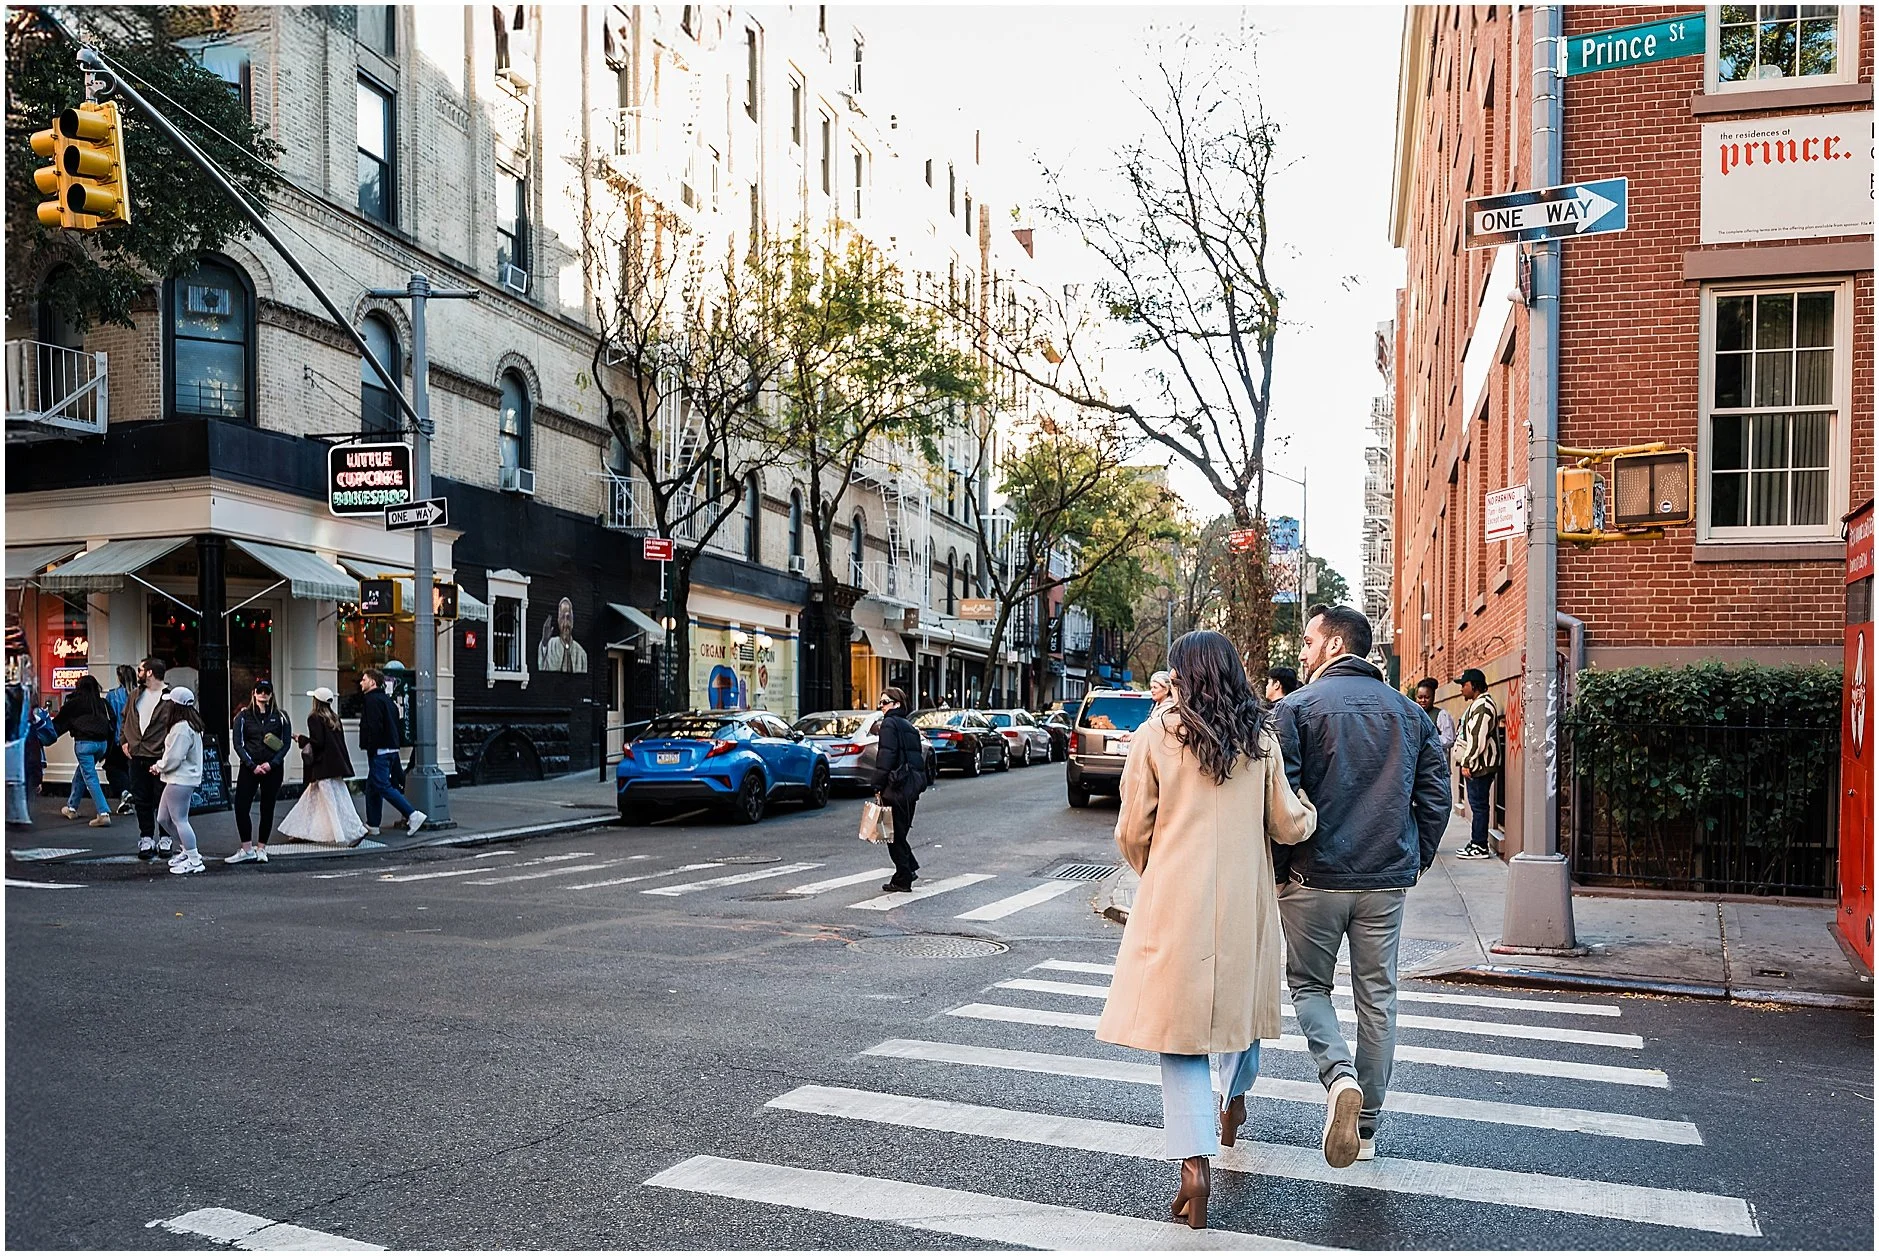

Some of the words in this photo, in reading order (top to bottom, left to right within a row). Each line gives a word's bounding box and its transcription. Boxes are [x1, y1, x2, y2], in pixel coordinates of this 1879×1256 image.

[1582, 34, 1656, 67] Prince
[1669, 22, 1685, 42] St
[1720, 132, 1733, 140] the
[1735, 130, 1780, 139] residences
[1720, 135, 1852, 176] prince.
[1482, 208, 1523, 231] ONE
[1546, 199, 1594, 223] WAY
[346, 451, 393, 468] LITTLE
[336, 469, 403, 487] CUPCAKE
[332, 489, 409, 506] BAKESHOP
[1488, 496, 1494, 505] NO
[1495, 491, 1516, 504] PARKING
[391, 512, 408, 523] ONE
[415, 508, 434, 520] WAY
[54, 638, 74, 658] Coffee
[73, 637, 88, 655] Shop
